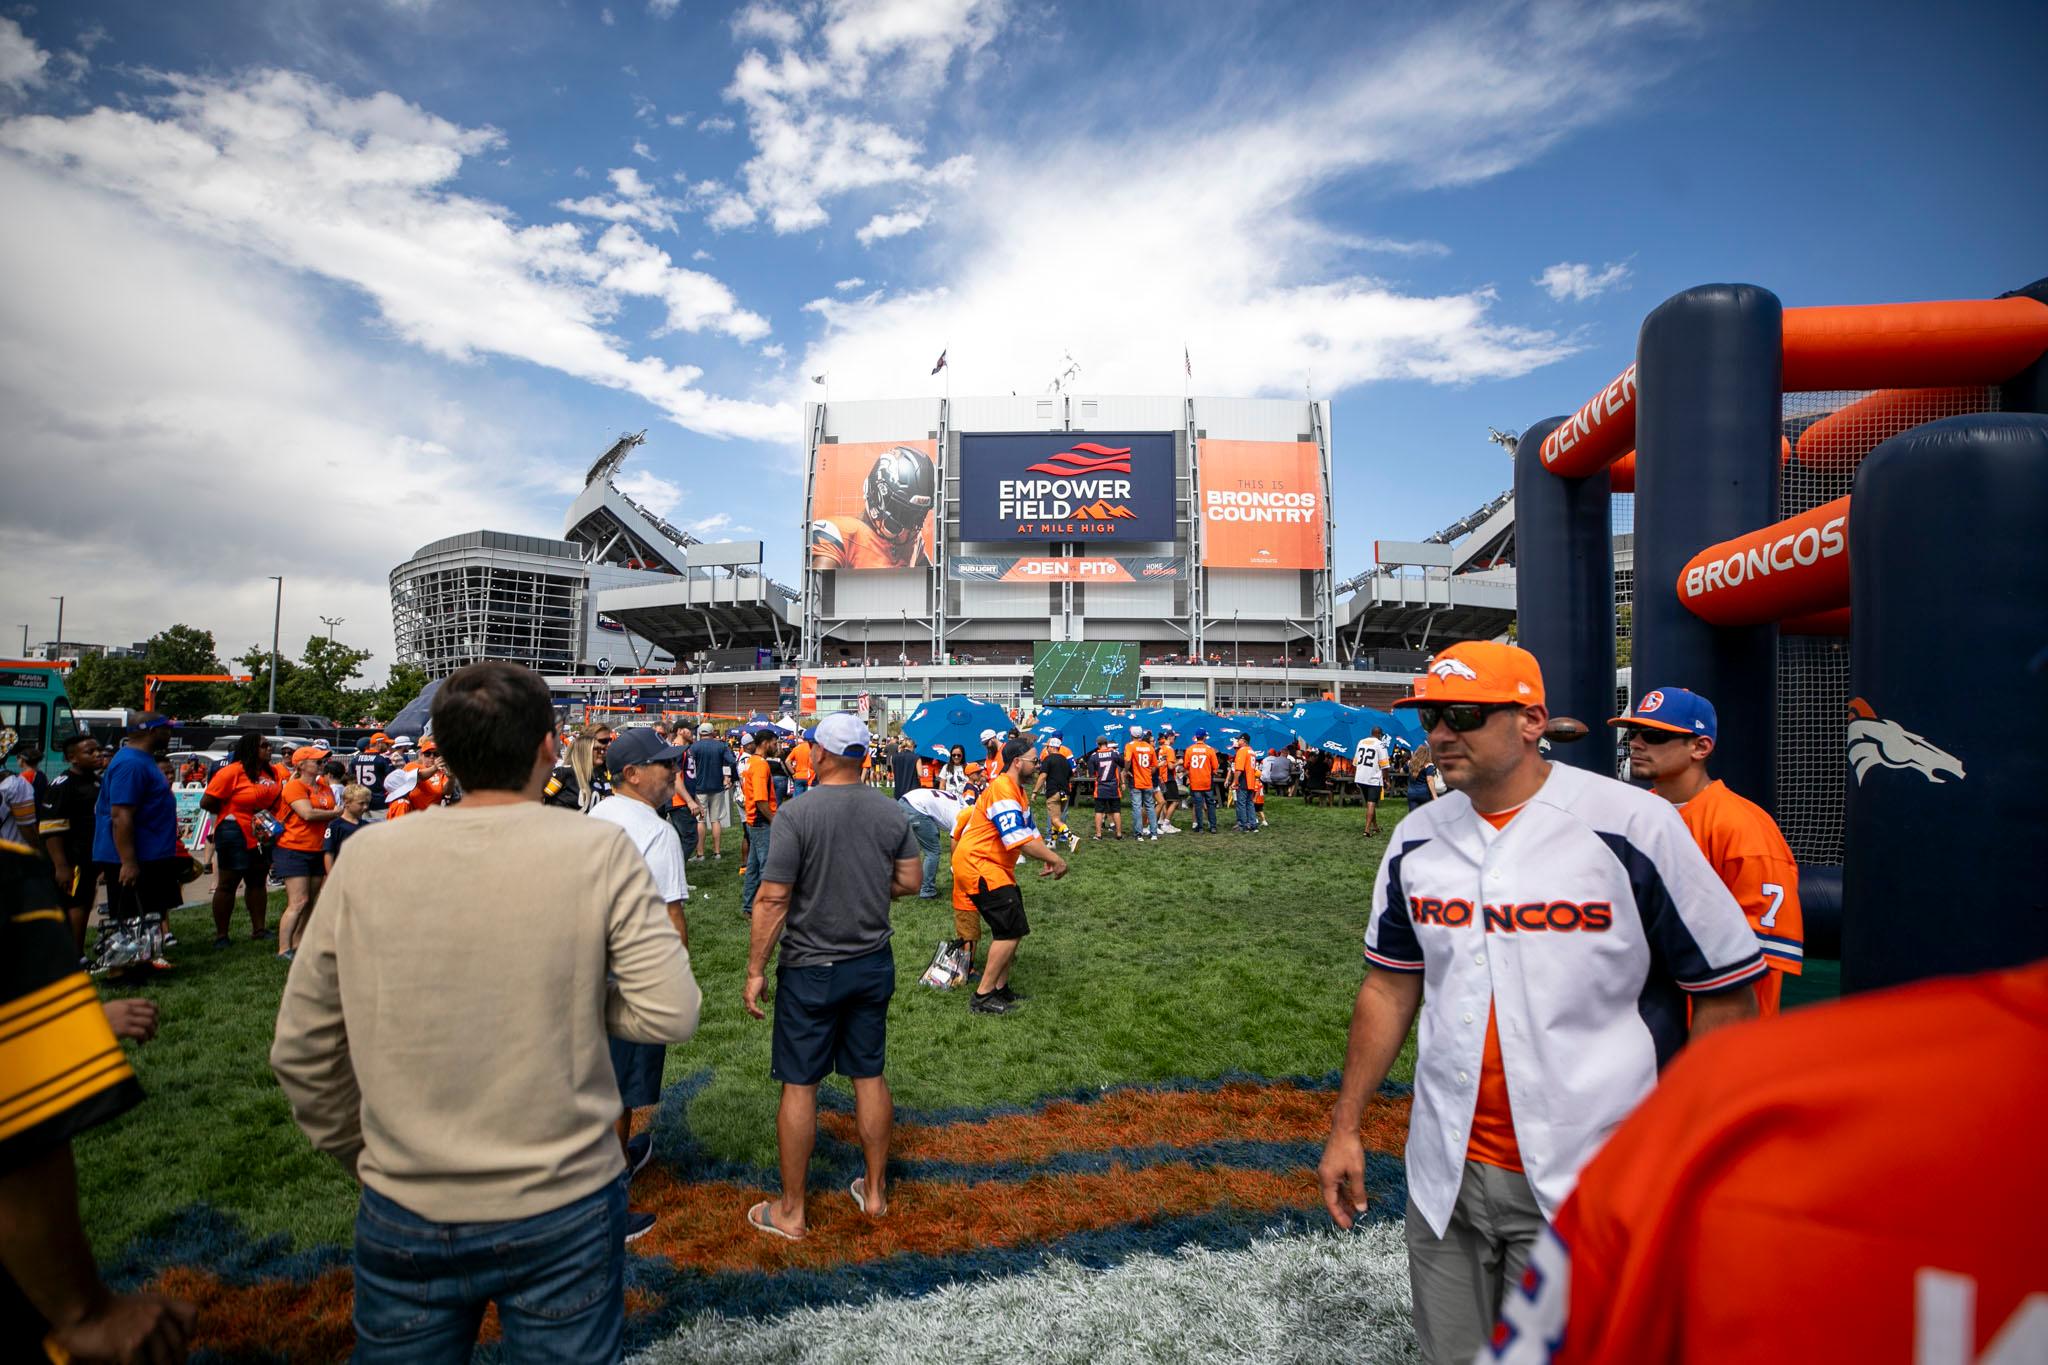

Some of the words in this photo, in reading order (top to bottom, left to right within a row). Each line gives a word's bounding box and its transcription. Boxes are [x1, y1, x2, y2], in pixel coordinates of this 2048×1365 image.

[1545, 363, 1636, 464] DENVER
[999, 480, 1131, 499] EMPOWER
[1238, 480, 1264, 489] THIS
[1272, 480, 1284, 489] IS
[1207, 490, 1316, 507] BRONCOS
[999, 500, 1071, 520] FIELD
[1208, 506, 1315, 523] COUNTRY
[1017, 524, 1034, 533] AT
[1041, 524, 1074, 533] MILE
[1081, 524, 1115, 533] HIGH
[1685, 516, 1846, 598] BRONCOS
[976, 565, 997, 573] LIGHT
[1027, 562, 1069, 574] DEN
[1080, 562, 1108, 574] PIT
[600, 660, 609, 668] 10
[13, 680, 47, 688] ON-A-STICK
[1323, 740, 1348, 753] Ford
[1138, 753, 1150, 768] 18
[1191, 755, 1207, 768] 87
[1357, 747, 1376, 767] 32
[355, 765, 377, 786] 15
[1099, 760, 1112, 781] 7
[998, 812, 1017, 832] 27
[1760, 884, 1784, 928] 7
